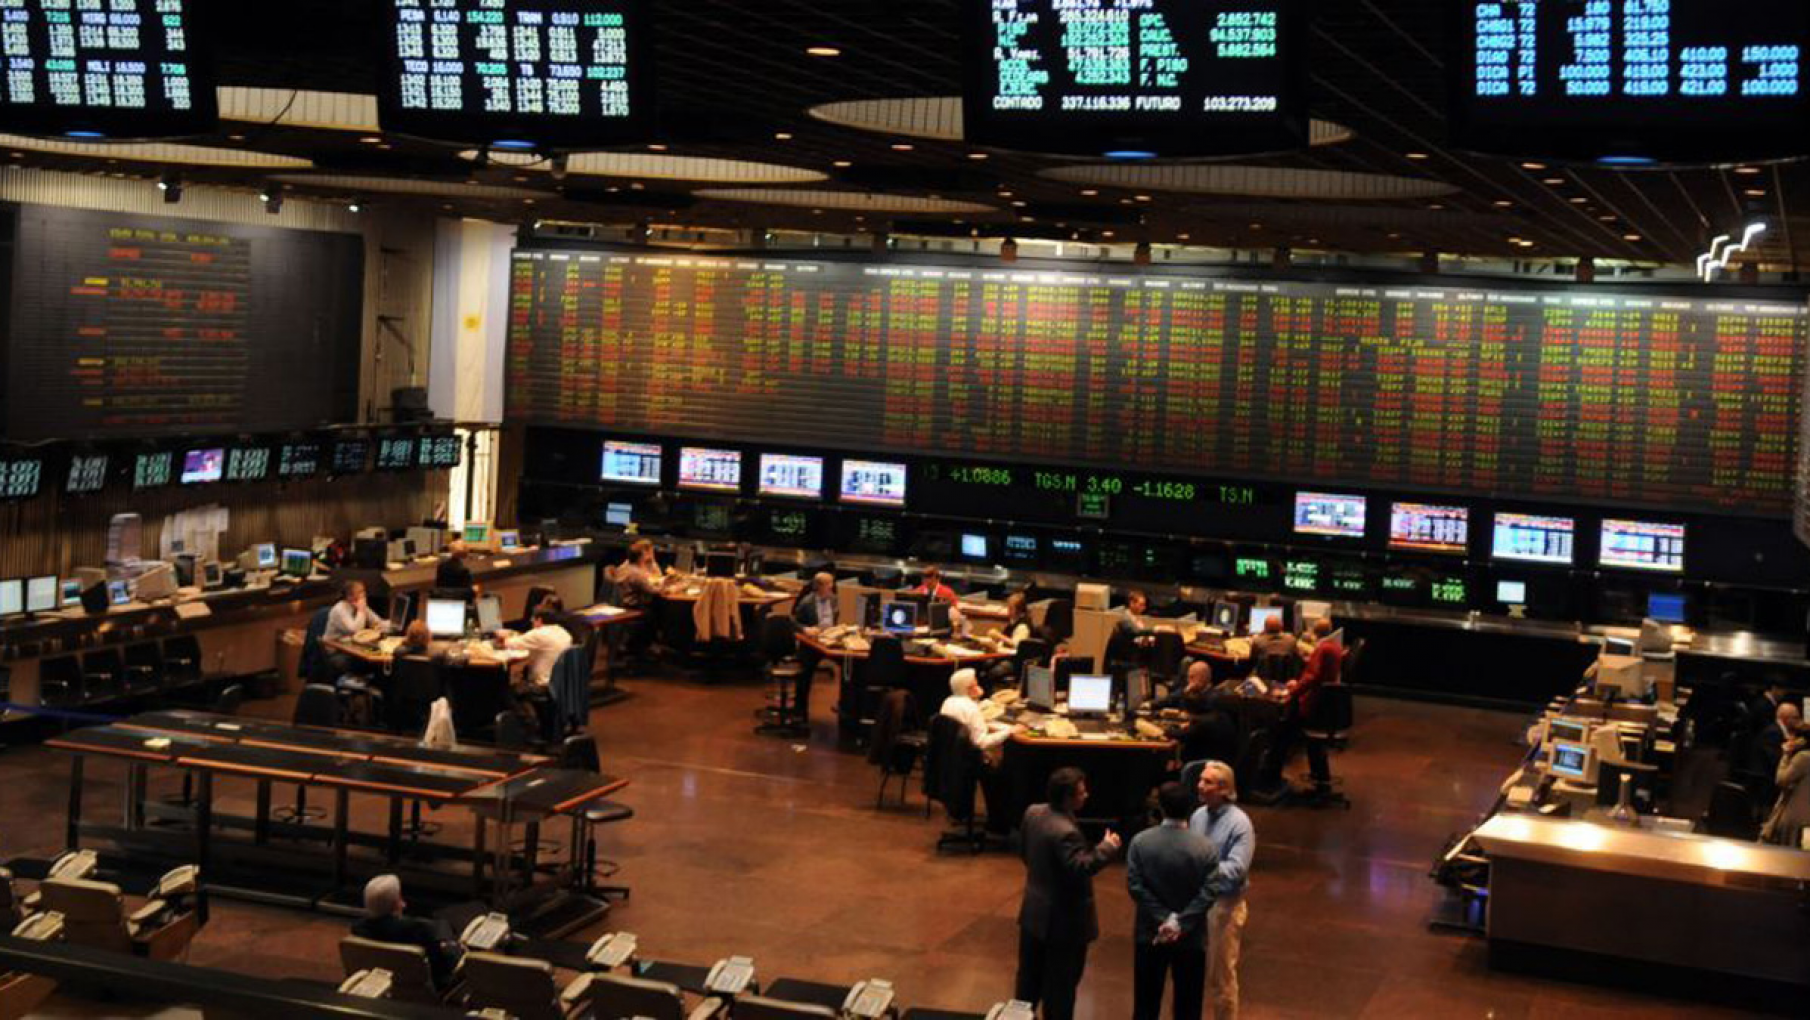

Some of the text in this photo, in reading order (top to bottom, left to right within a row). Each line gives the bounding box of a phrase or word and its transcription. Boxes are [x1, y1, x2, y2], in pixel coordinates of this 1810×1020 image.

[1518, 3, 1535, 16] 72
[1518, 19, 1535, 32] 72
[1518, 35, 1535, 48] 72
[1518, 51, 1535, 63] 72
[1680, 47, 1727, 62] 410.00
[1742, 46, 1799, 62] 150.000
[1559, 65, 1610, 80] 100.000
[1759, 63, 1797, 77] 1.000
[1518, 81, 1535, 95] 72
[1566, 81, 1610, 95] 50.000
[1742, 80, 1798, 95] 100.000
[993, 96, 1042, 108] CONTADO
[1135, 97, 1181, 109] FUTURO
[1034, 472, 1076, 489] TGS.N
[1087, 478, 1122, 494] 3.40
